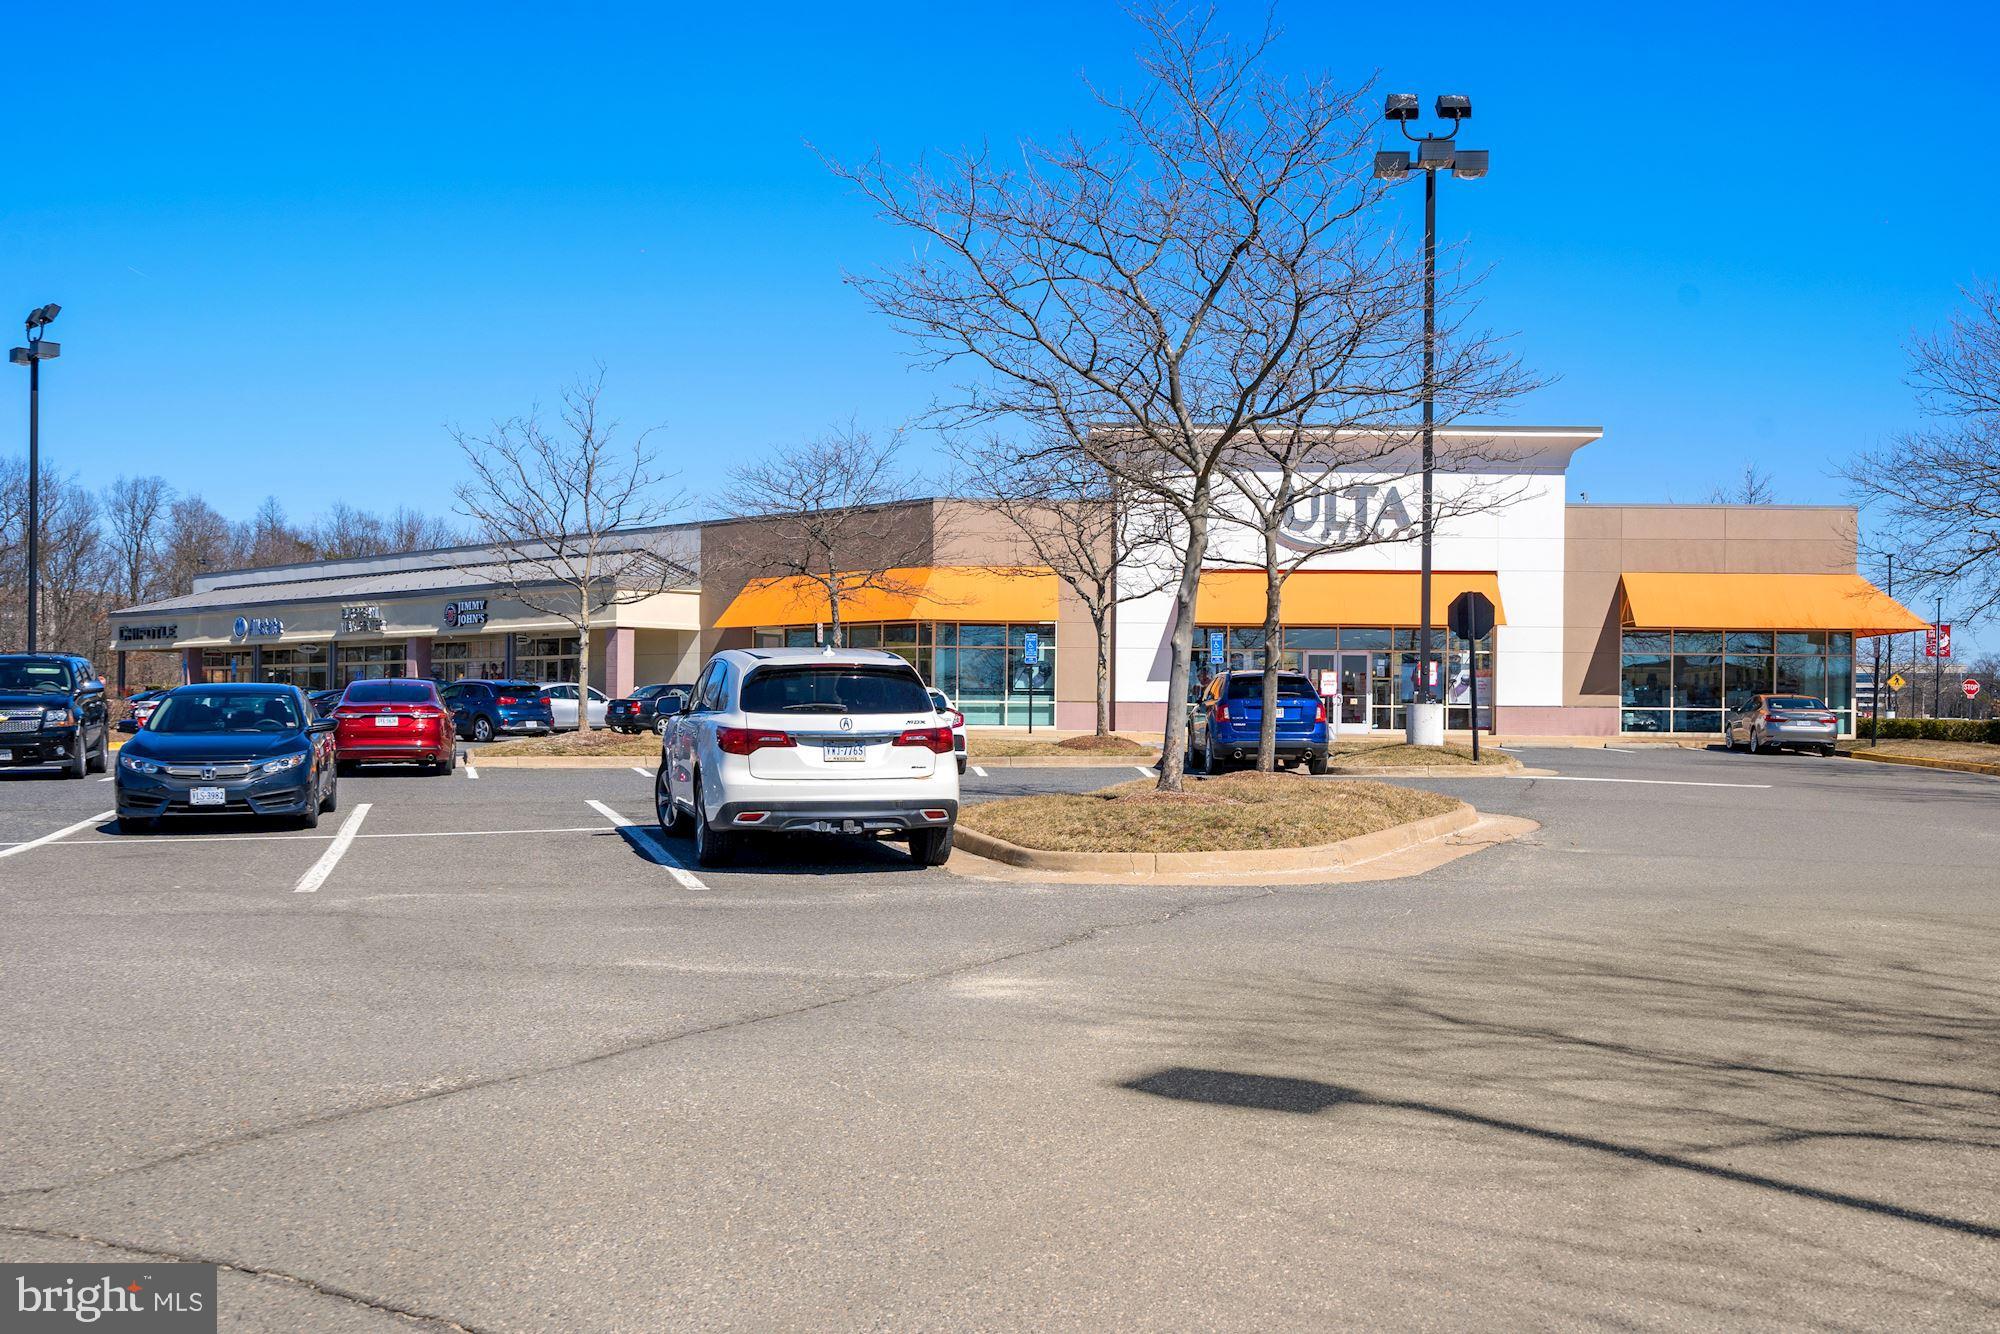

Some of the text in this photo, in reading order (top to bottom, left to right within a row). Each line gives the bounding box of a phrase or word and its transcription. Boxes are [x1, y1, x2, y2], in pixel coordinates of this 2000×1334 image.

[1284, 485, 1412, 533] ULTA
[457, 600, 486, 613] JIMMY
[457, 613, 486, 627] JOHN'S
[119, 624, 178, 641] CHIPOTLE
